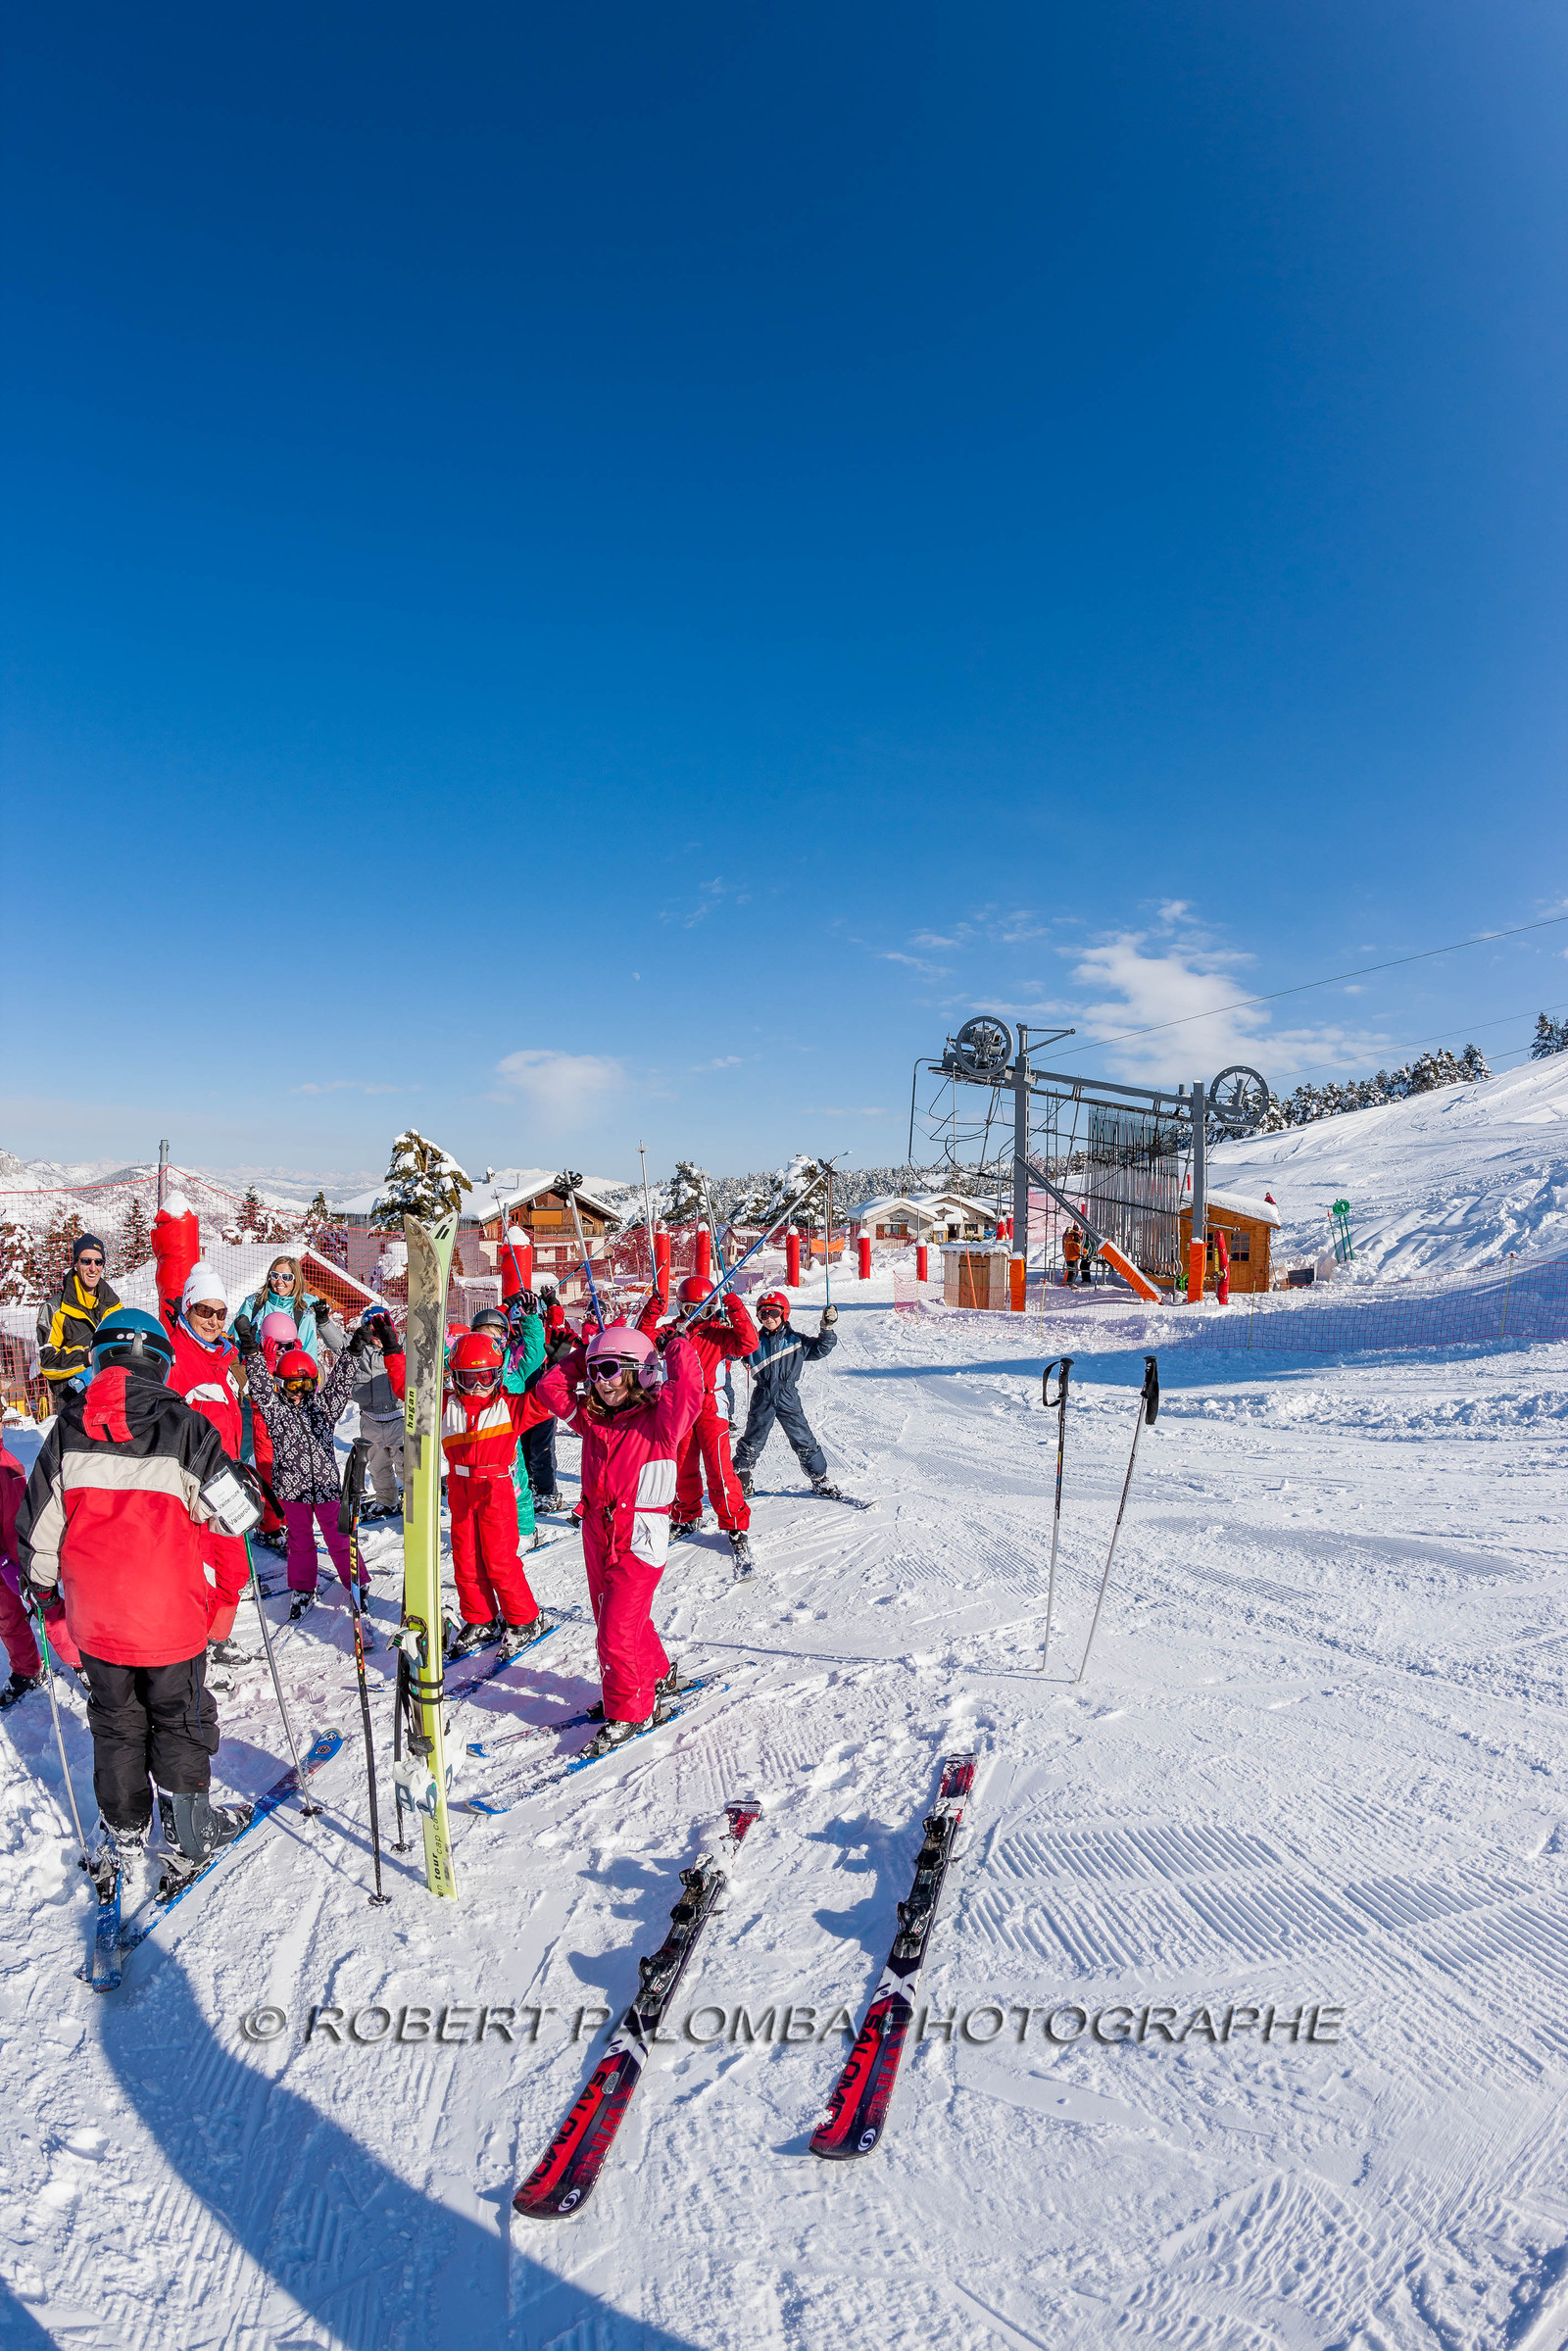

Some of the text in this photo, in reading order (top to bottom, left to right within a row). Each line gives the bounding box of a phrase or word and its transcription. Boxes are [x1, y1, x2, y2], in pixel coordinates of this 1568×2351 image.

[407, 1390, 416, 1429] hagan
[432, 1853, 441, 1880] tour
[520, 2071, 607, 2195] SALOMON
